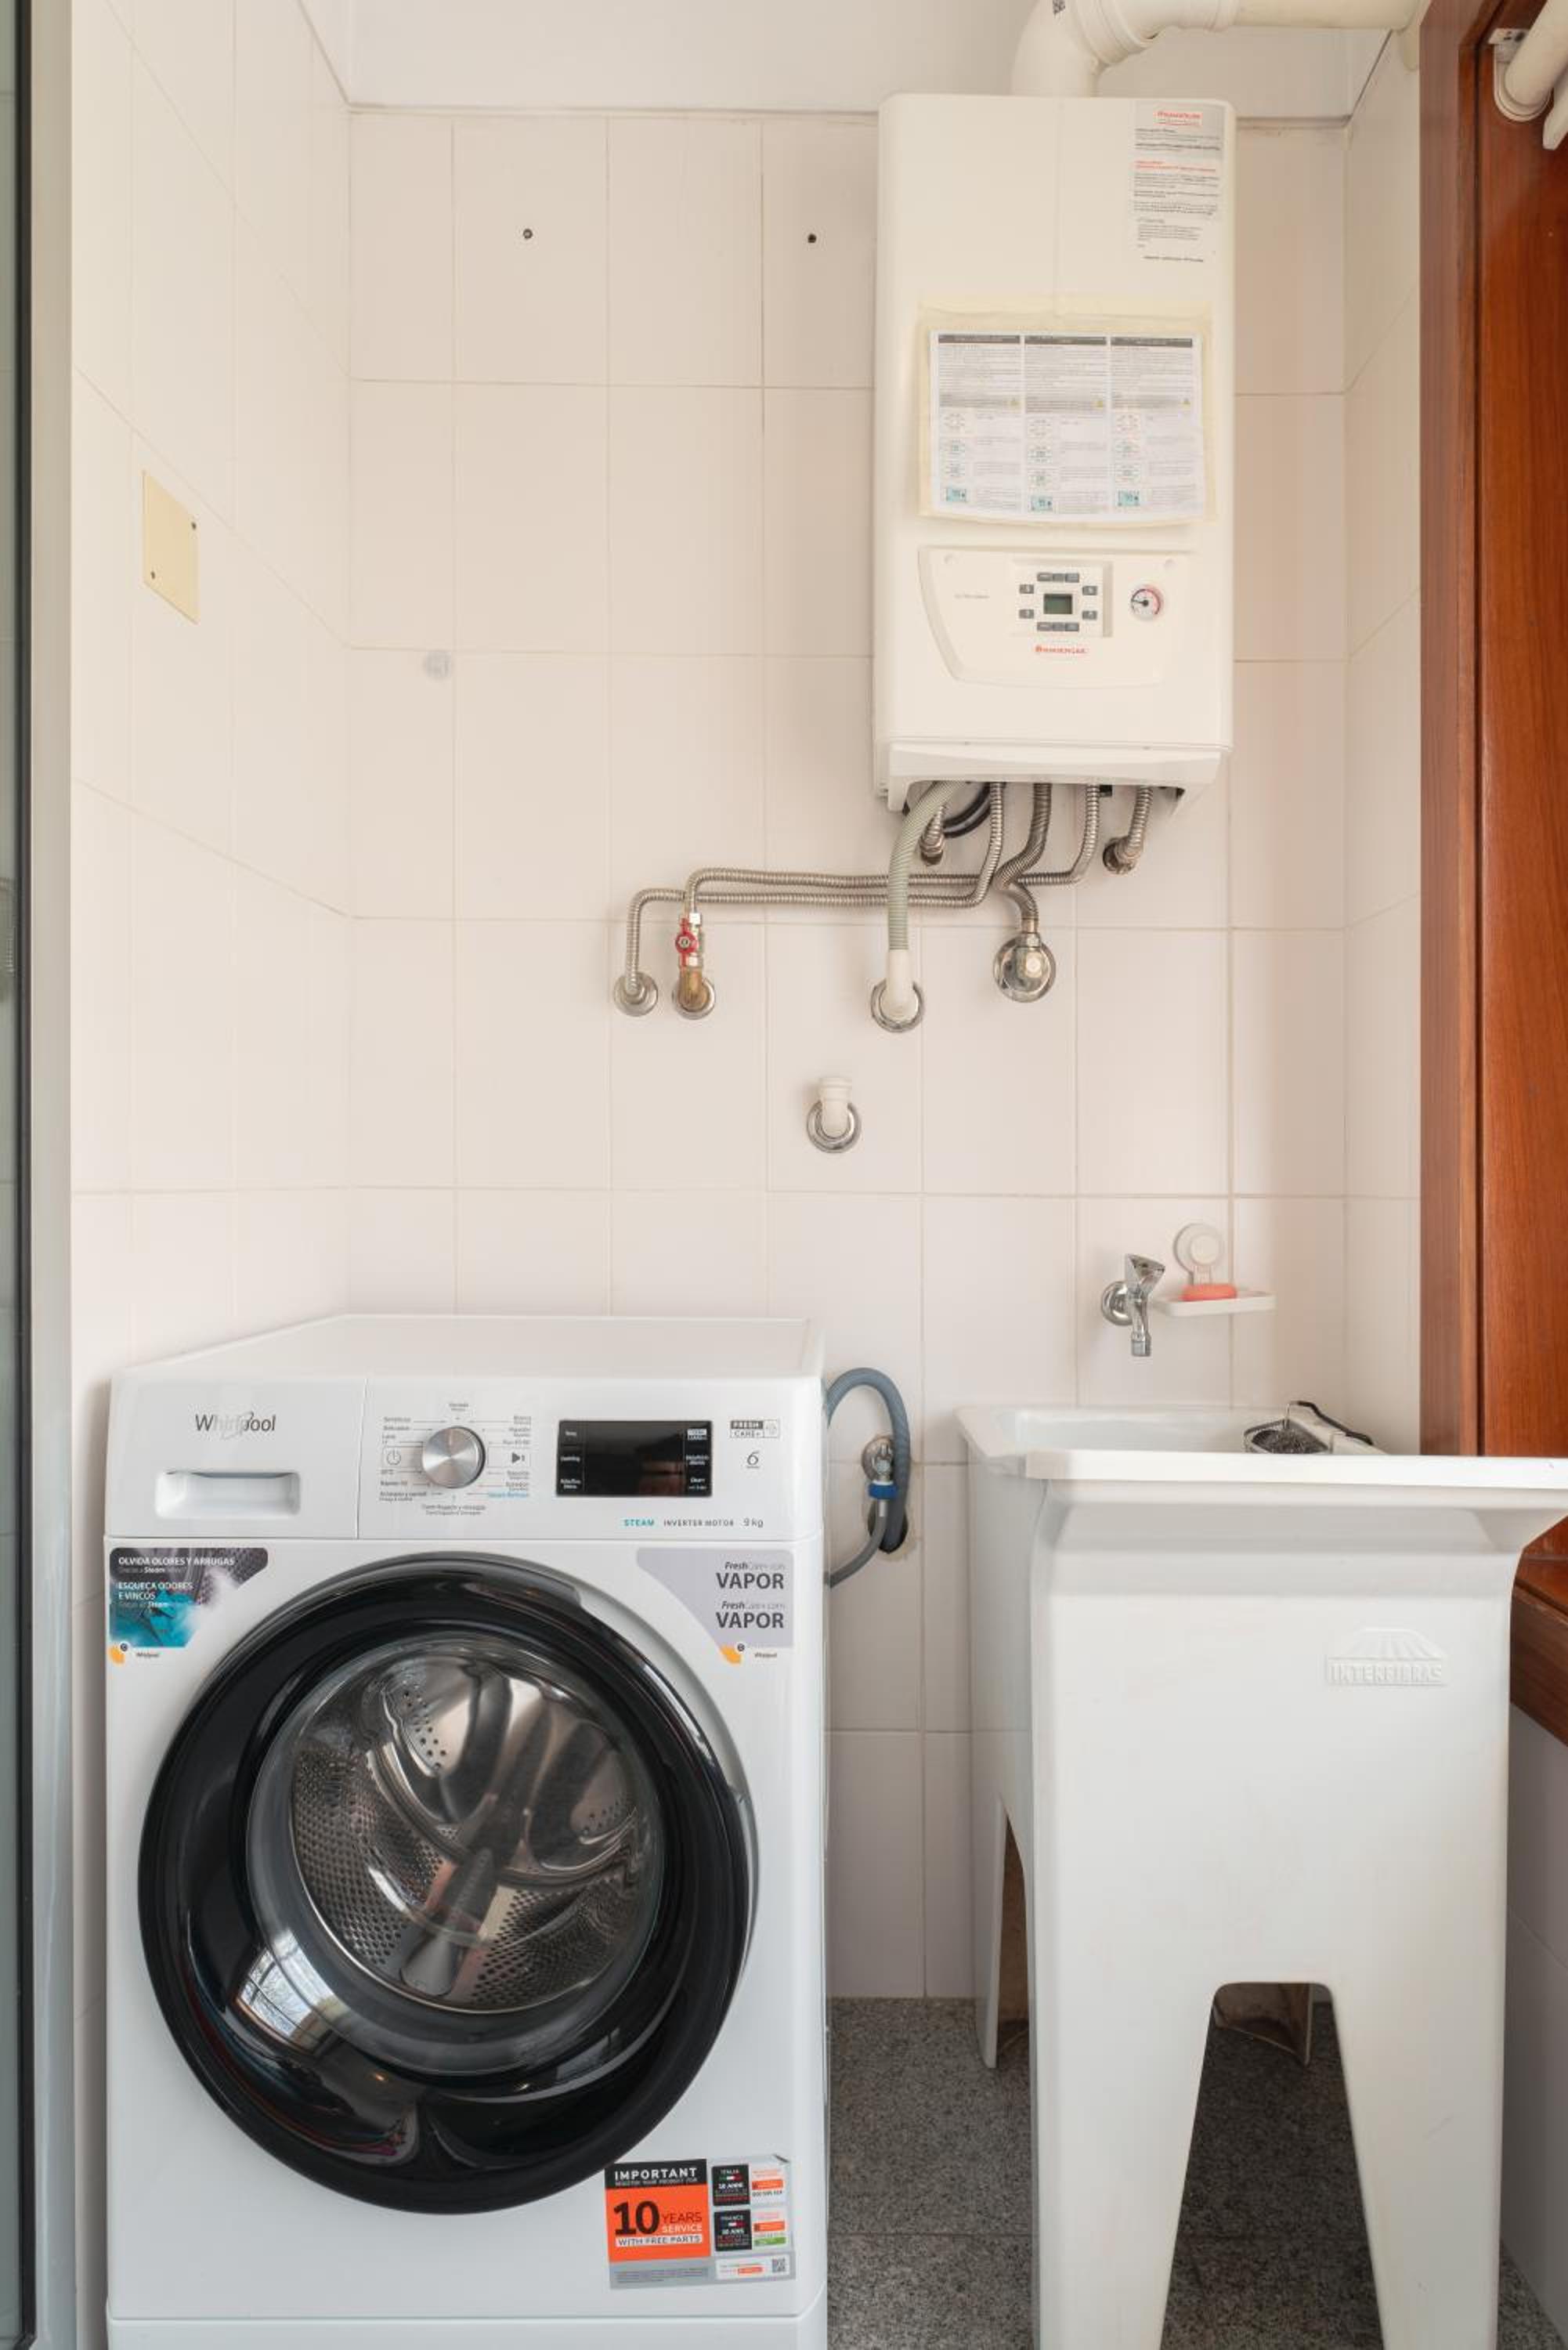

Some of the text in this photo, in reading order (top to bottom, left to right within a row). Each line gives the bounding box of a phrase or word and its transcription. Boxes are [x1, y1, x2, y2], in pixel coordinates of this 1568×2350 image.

[195, 1411, 276, 1440] Whirlpool
[118, 1556, 150, 1566] OLVIDA
[151, 1556, 186, 1566] OLORES
[193, 1556, 235, 1566] ARRUGAS
[118, 1582, 193, 1590] ESQUECA ODORES
[716, 1572, 784, 1589] VAPOR
[716, 1611, 784, 1629] VAPOR
[614, 2167, 697, 2181] IMPORTANT
[613, 2200, 659, 2236] 10
[662, 2211, 703, 2224] YEARS
[662, 2224, 703, 2233] SERVICE
[618, 2235, 700, 2247] WITH FREE PARTS
